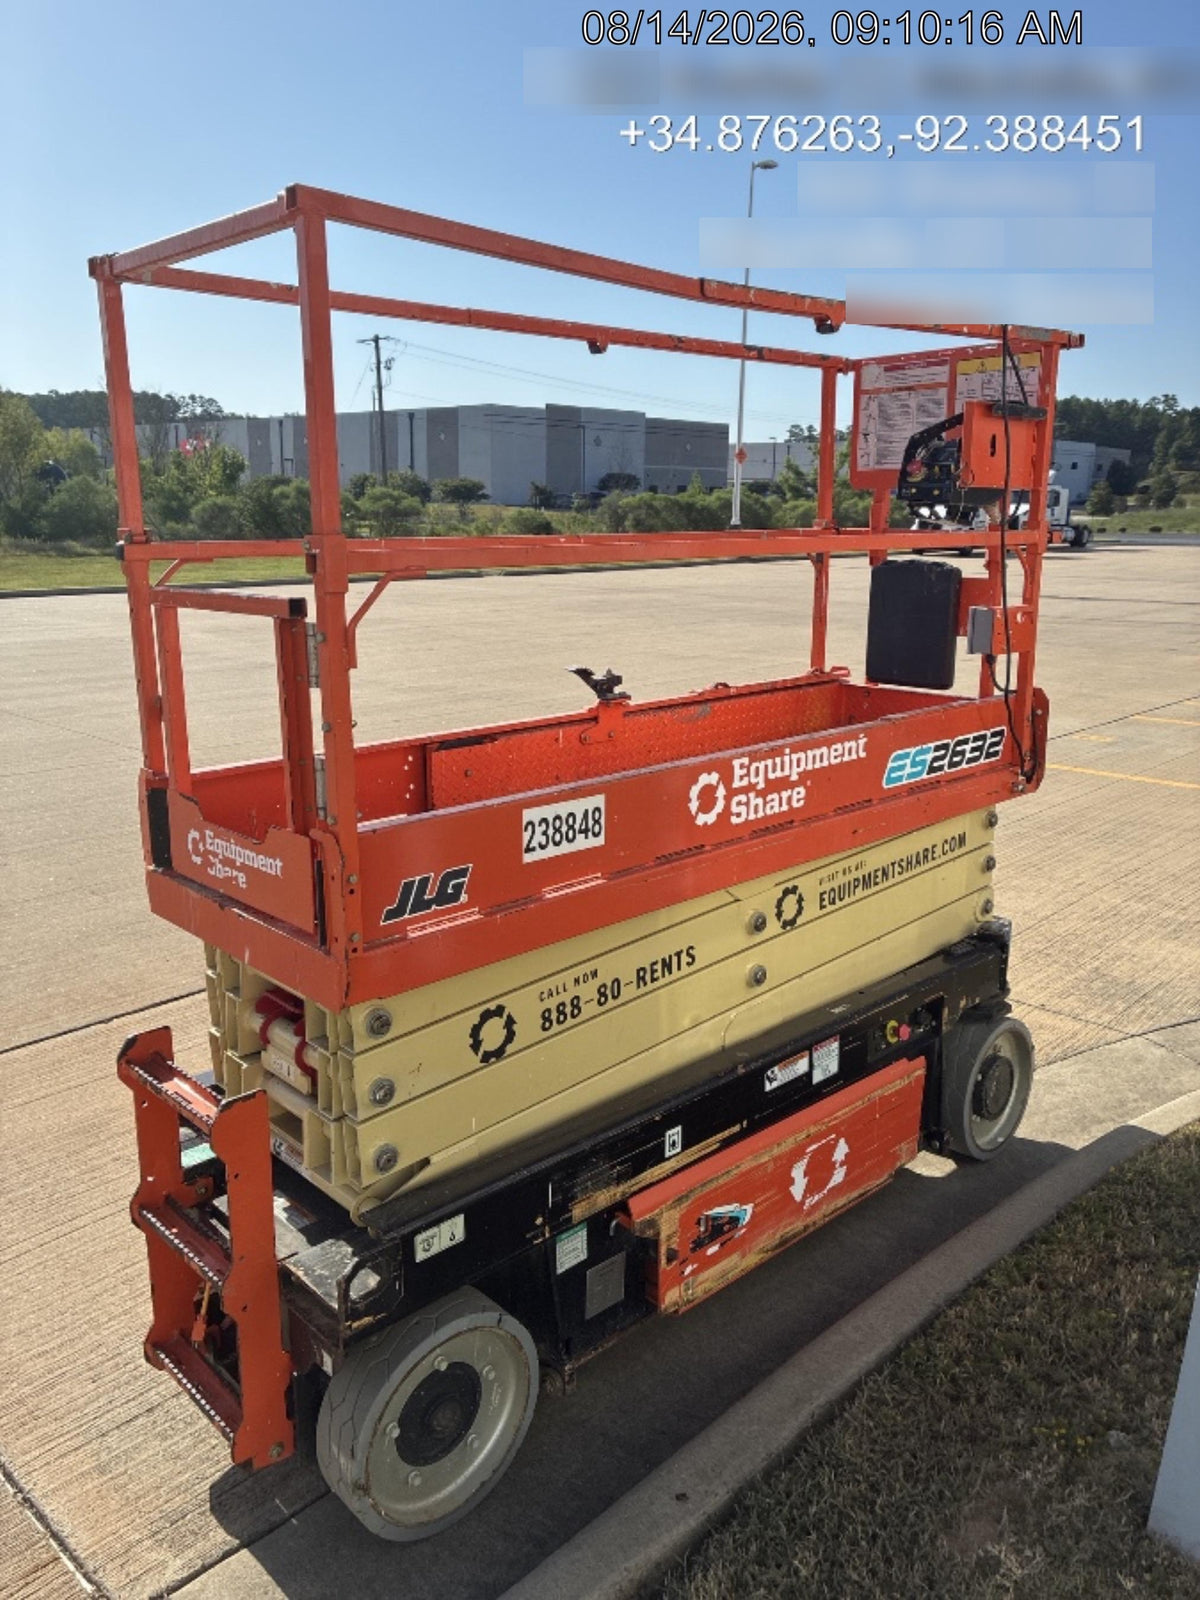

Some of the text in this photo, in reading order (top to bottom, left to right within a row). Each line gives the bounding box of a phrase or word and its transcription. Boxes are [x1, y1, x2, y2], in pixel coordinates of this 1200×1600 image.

[731, 734, 868, 788] Equipment
[883, 727, 1006, 789] ES2632
[523, 806, 603, 854] 238848
[730, 785, 806, 825] Share
[204, 829, 284, 879] Equipment
[818, 831, 967, 911] EQUIPMENTSHARE.COM
[380, 864, 473, 925] JLG
[539, 968, 600, 1003] CALL NOW
[540, 945, 697, 1033] 888-80-RENTS
